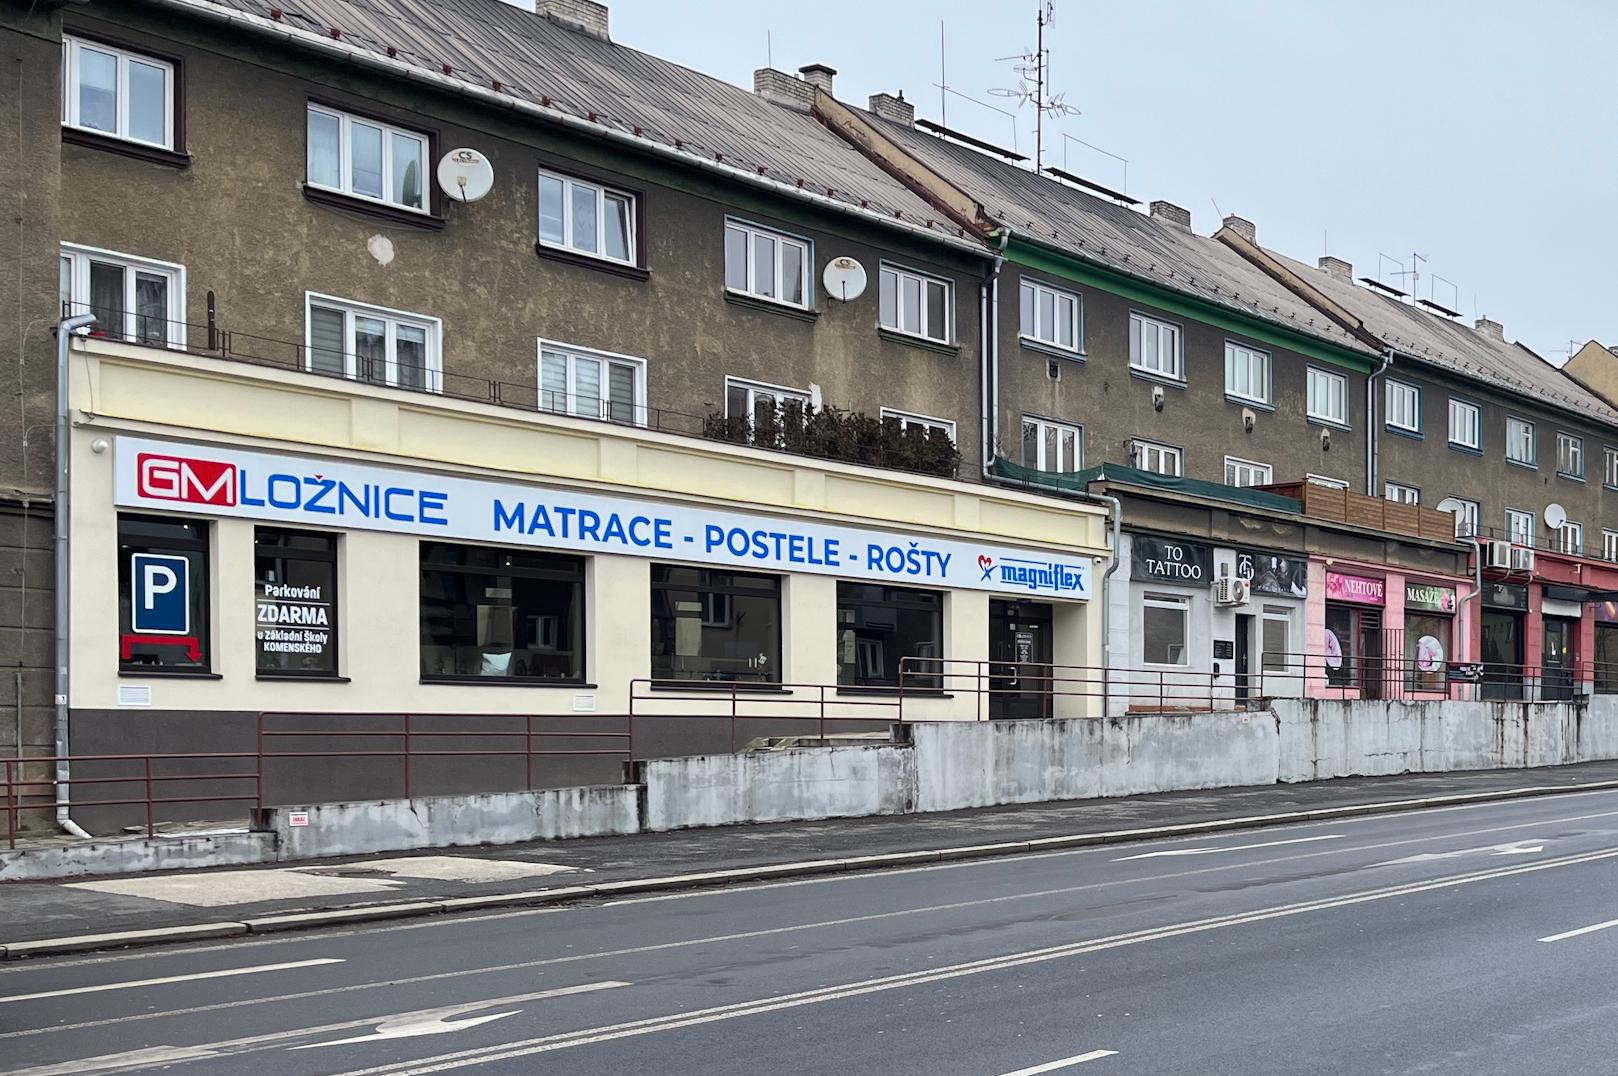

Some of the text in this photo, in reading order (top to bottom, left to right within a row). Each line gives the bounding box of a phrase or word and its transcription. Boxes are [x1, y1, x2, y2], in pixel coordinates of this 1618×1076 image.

[141, 458, 449, 526] GM LOŽNICE
[493, 498, 673, 549] MATRACE
[704, 524, 840, 567] POSTELE
[866, 541, 952, 578] ROŠTY
[1164, 545, 1183, 560] TO
[1000, 562, 1084, 591] magniflex
[1145, 558, 1202, 580] TATTOO
[144, 564, 178, 610] P
[264, 584, 321, 599] Parkování
[1344, 579, 1383, 597] NEHTOVÉ
[257, 604, 328, 625] ZDARMA
[257, 629, 328, 645] u Základní Školy
[263, 641, 322, 654] KOMENSKÉHO
